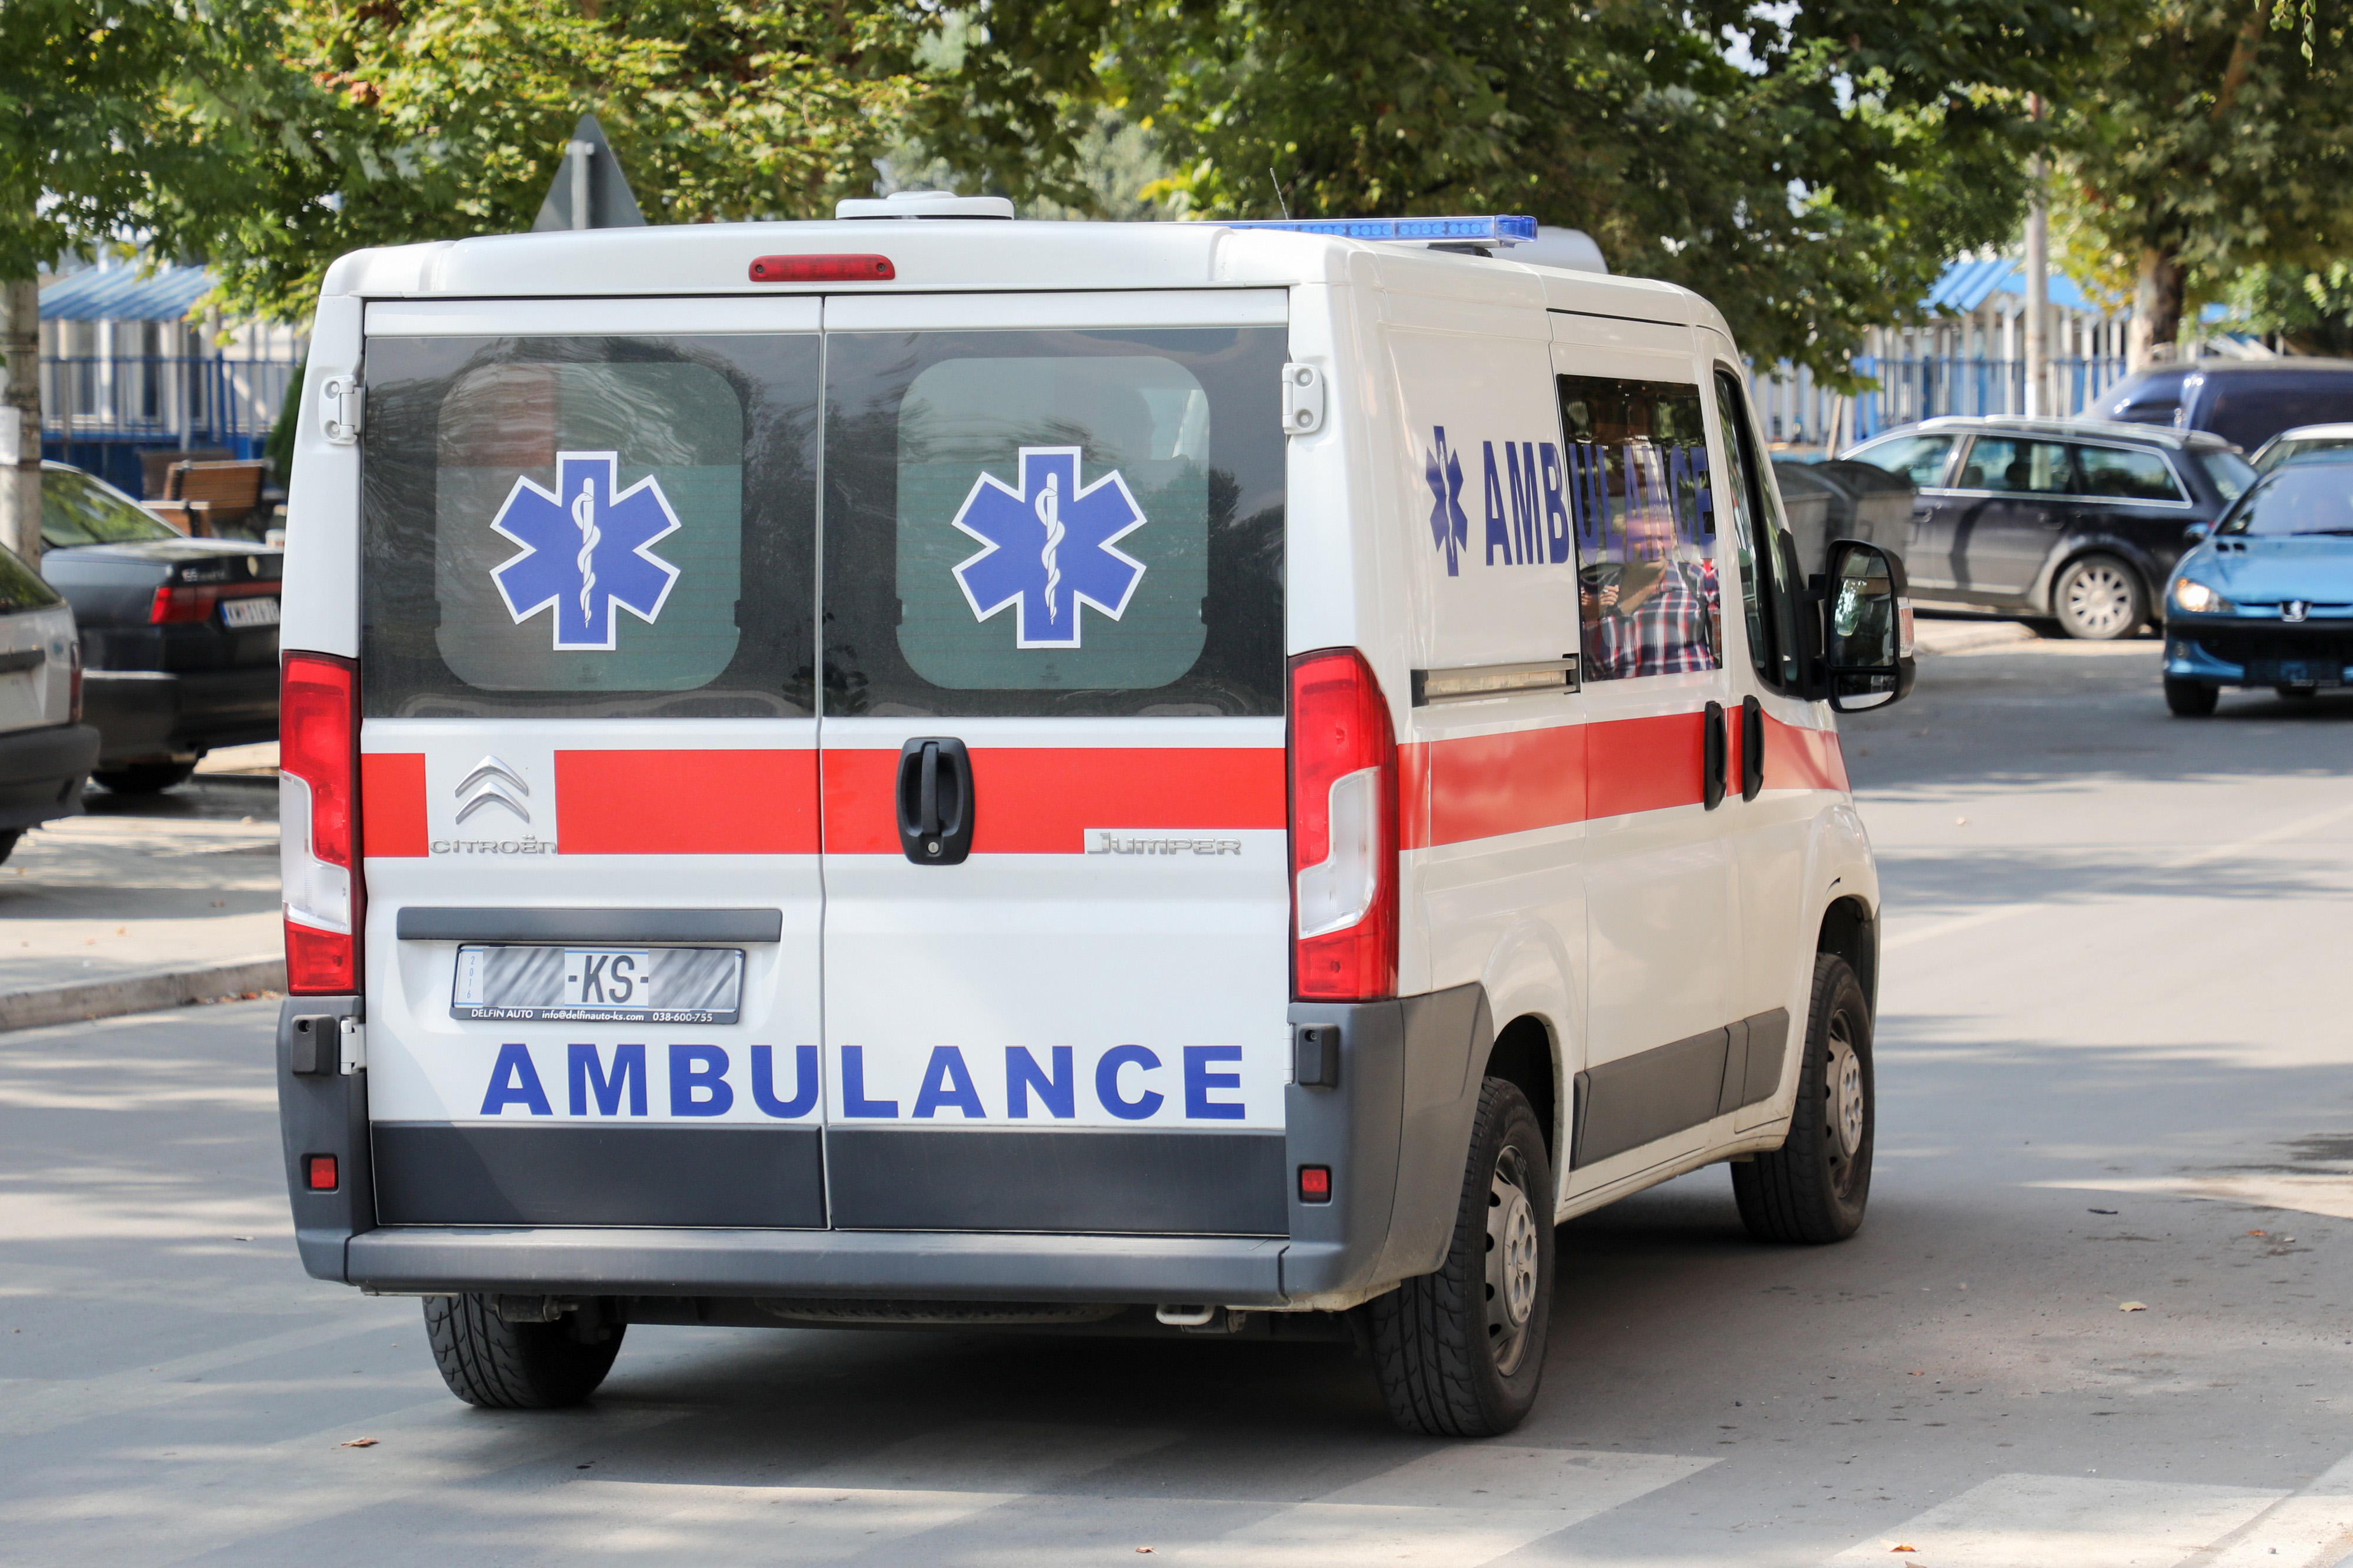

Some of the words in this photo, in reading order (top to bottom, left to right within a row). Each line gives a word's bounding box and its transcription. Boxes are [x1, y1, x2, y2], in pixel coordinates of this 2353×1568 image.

[1483, 441, 1717, 566] AMBULANCE
[466, 956, 475, 999] 2016
[471, 1009, 504, 1018] DELFIN
[506, 1010, 533, 1019] AUTO
[542, 1010, 644, 1022] info@delfinauto-ks.com
[652, 1012, 713, 1022] 038-600-755
[479, 1043, 1246, 1120] AMBULANCE
